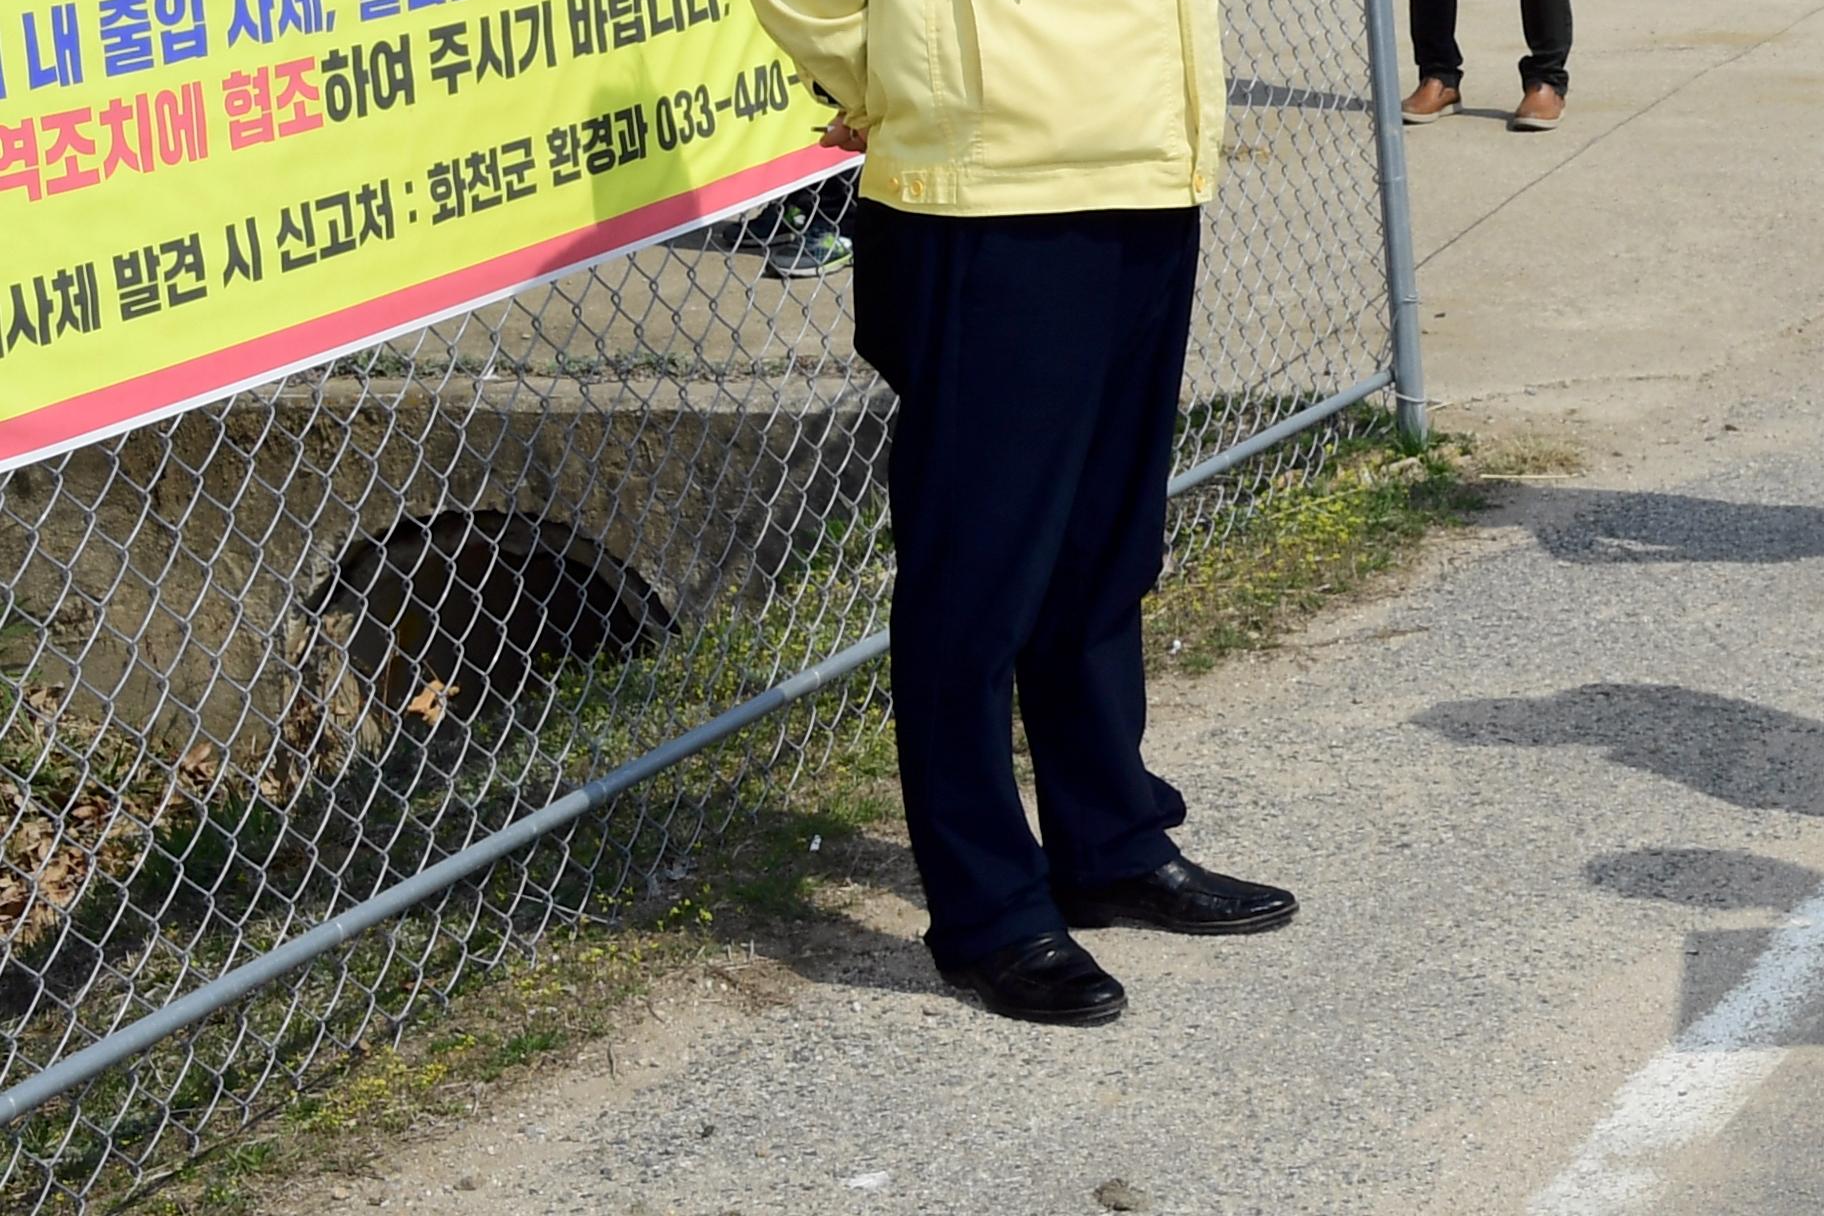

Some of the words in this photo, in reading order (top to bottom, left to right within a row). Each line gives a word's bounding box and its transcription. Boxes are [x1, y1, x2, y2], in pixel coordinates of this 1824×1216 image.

[21, 2, 84, 90] 내
[221, 33, 416, 151] 협조하여
[428, 0, 556, 96] 주시기
[112, 232, 208, 322] 발견
[222, 216, 264, 289] 시
[276, 178, 395, 274] 신고처
[404, 180, 418, 224] :
[427, 137, 537, 226] 화천군
[546, 103, 648, 187] 환경과
